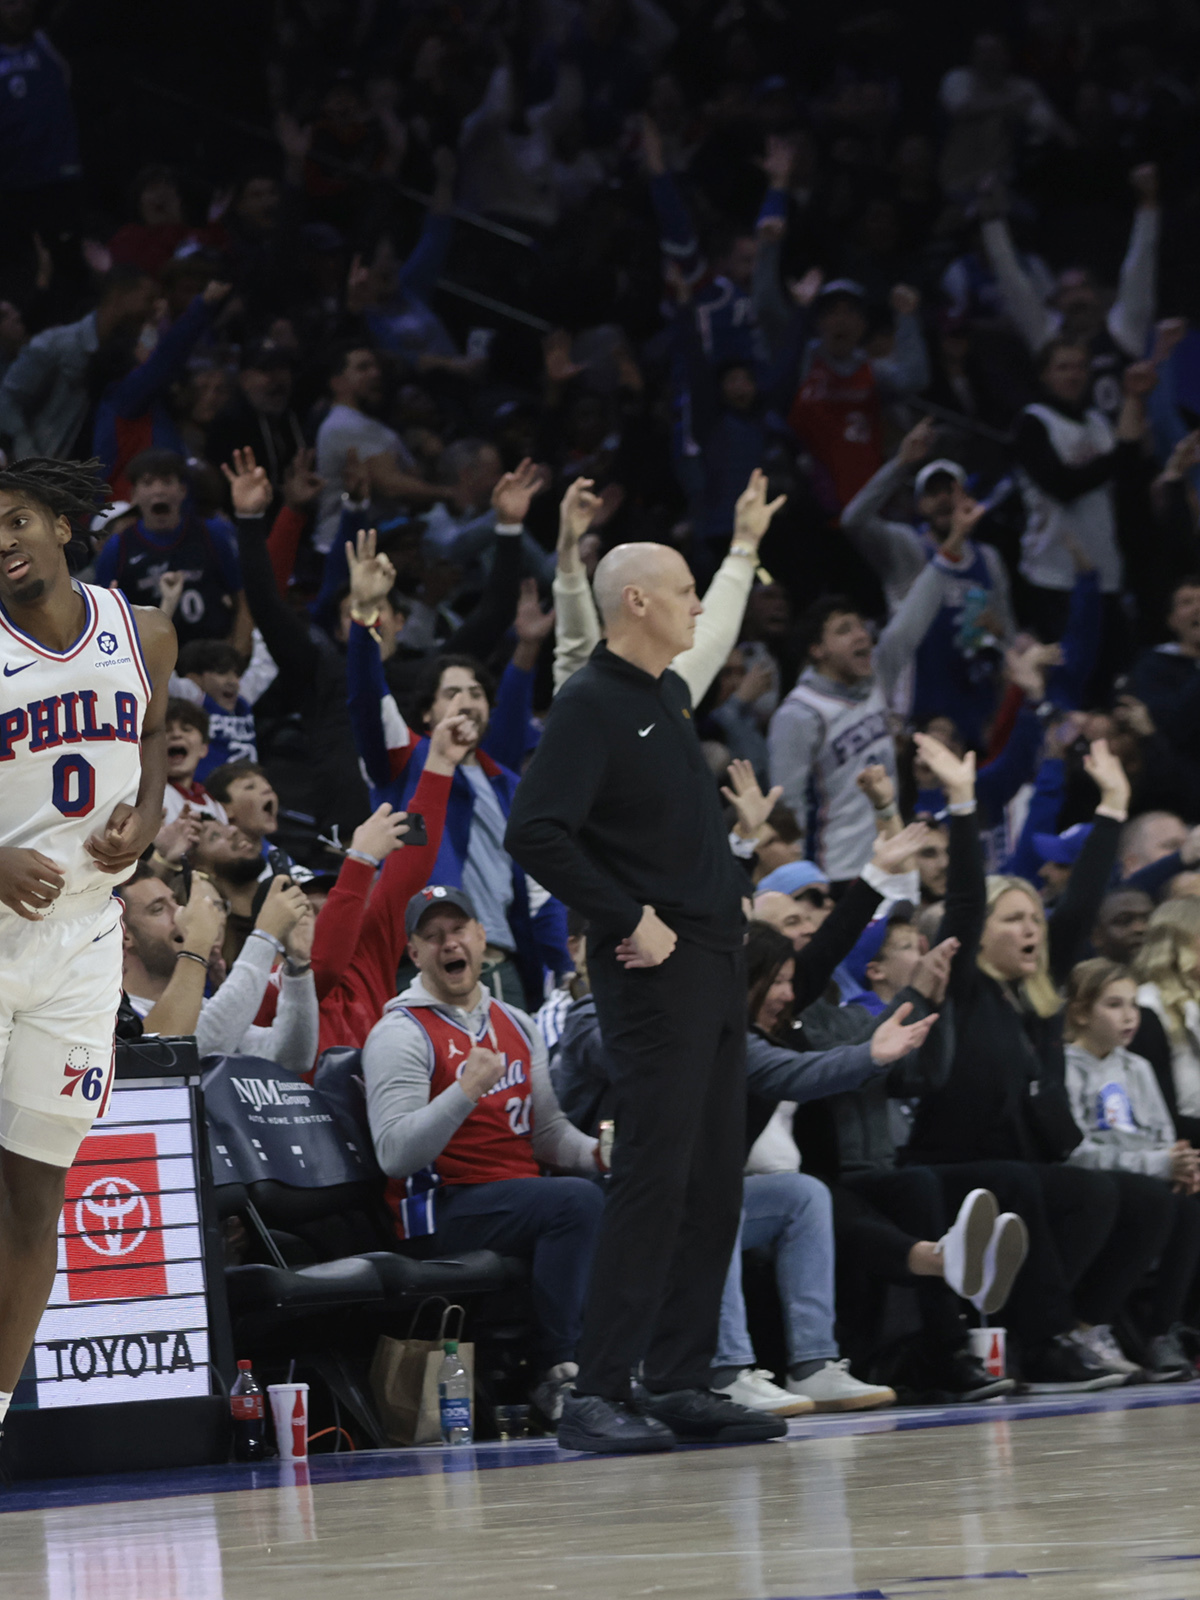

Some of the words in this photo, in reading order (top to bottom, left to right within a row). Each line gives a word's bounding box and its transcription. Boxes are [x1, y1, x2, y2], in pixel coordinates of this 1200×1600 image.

[179, 588, 205, 624] 0
[94, 656, 132, 669] crypto.com
[52, 754, 95, 818] 0
[60, 1062, 104, 1102] 76
[229, 1077, 284, 1112] NJM
[48, 1332, 195, 1382] TOYOTA
